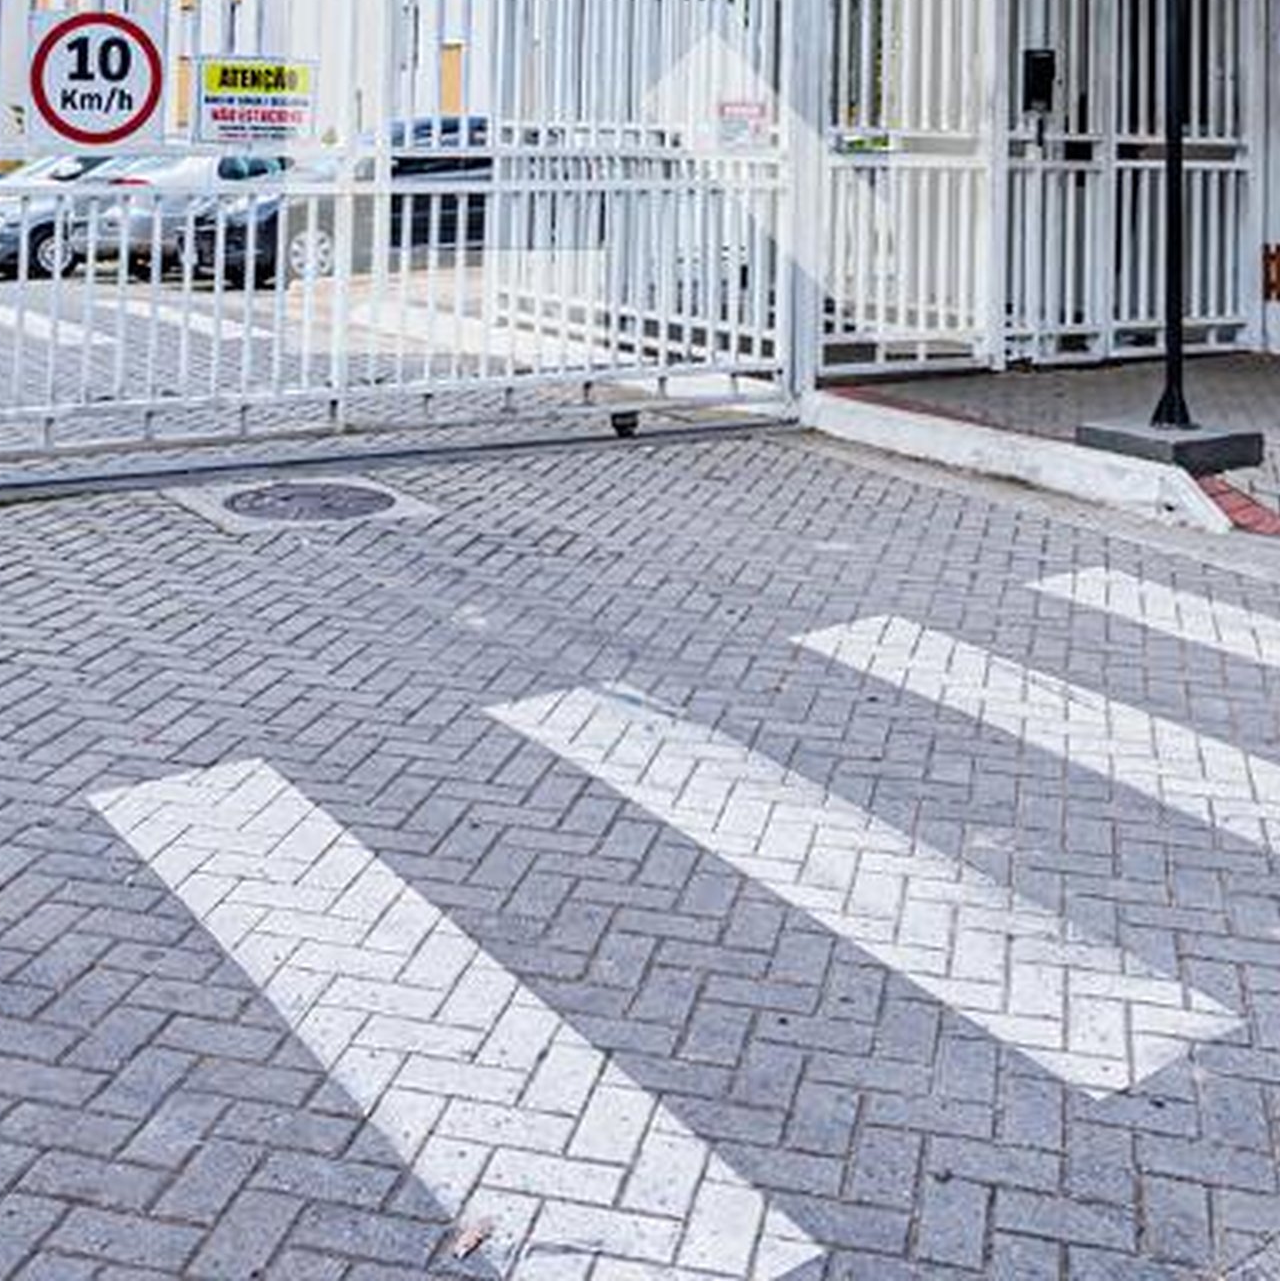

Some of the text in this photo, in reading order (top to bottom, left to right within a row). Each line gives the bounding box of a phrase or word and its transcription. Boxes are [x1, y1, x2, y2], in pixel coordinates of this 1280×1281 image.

[66, 36, 132, 82] 10
[218, 65, 298, 91] ATENÇÃO
[60, 87, 133, 113] Km/h
